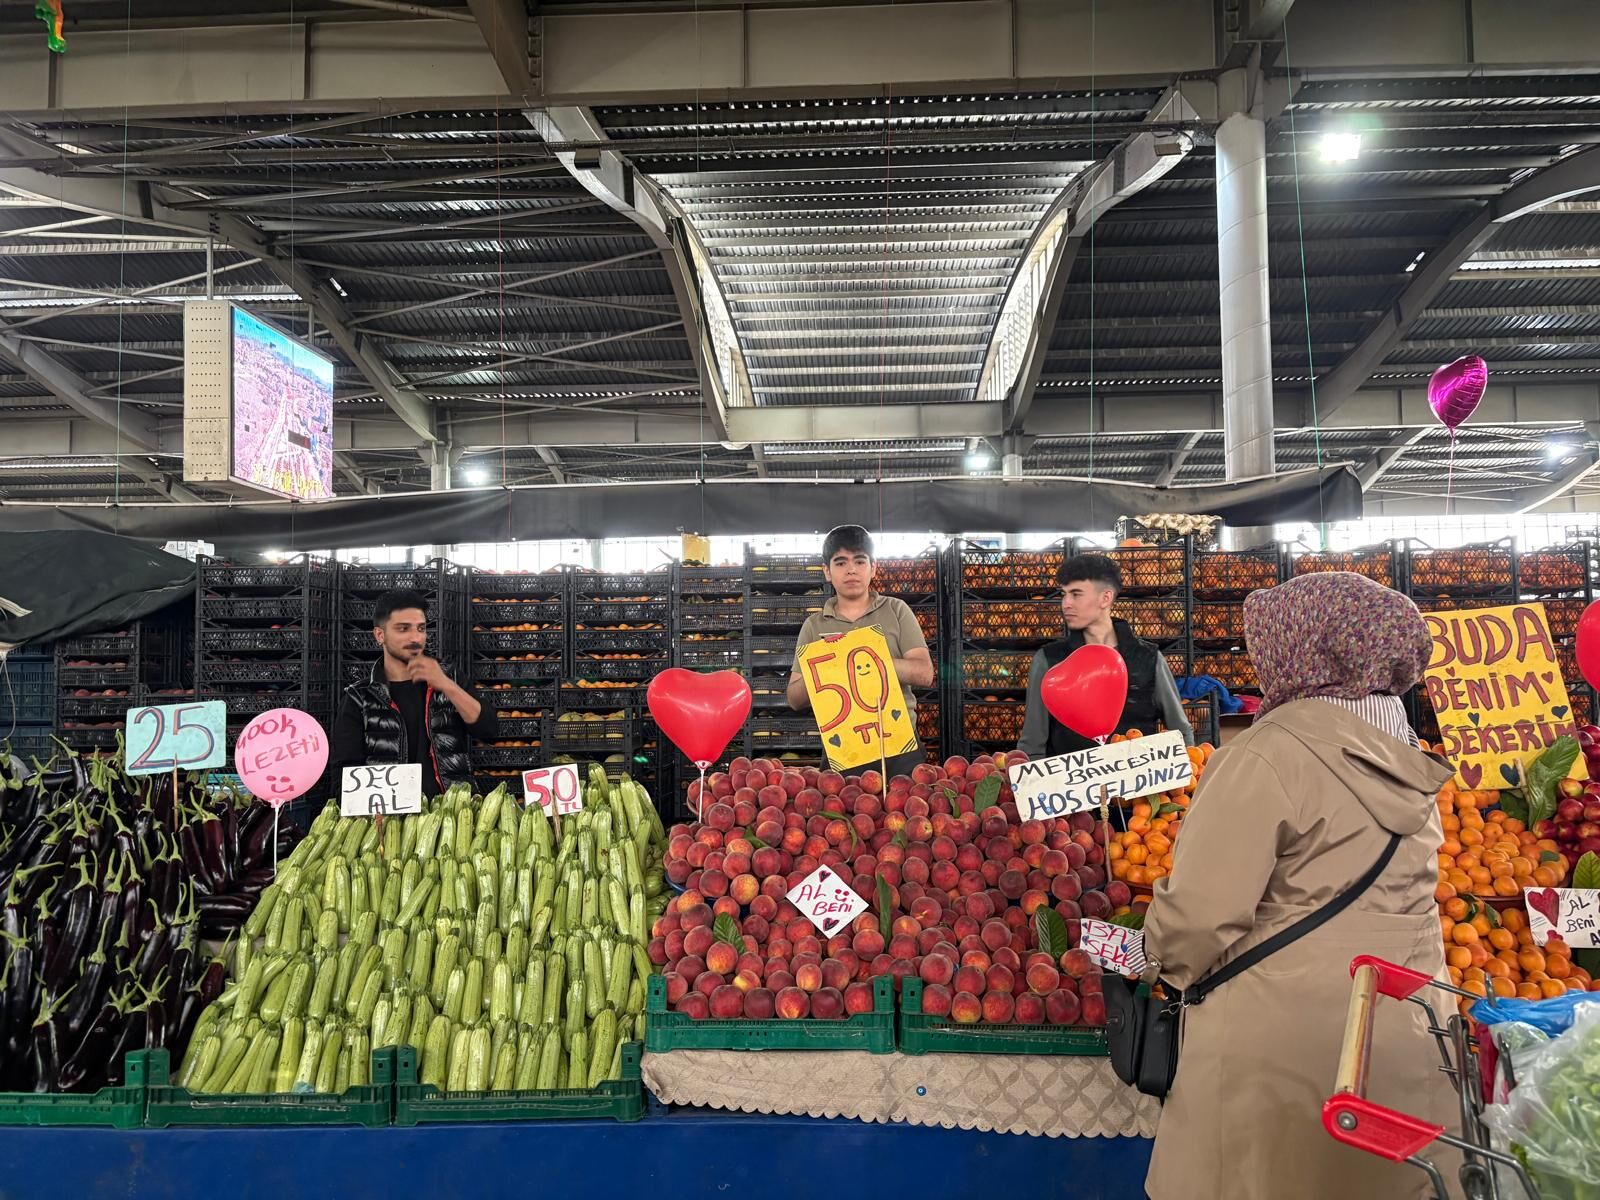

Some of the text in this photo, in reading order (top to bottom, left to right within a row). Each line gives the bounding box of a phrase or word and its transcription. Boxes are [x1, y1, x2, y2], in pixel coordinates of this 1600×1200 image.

[1423, 606, 1556, 670] BUDA
[807, 645, 889, 733] 50
[128, 705, 215, 771] 25
[853, 722, 892, 744] TL
[1016, 748, 1105, 784] MEYVE
[525, 767, 577, 808] 50
[368, 793, 414, 815] AL
[560, 801, 582, 813] TL
[795, 884, 826, 904] AL
[1565, 896, 1591, 917] AL
